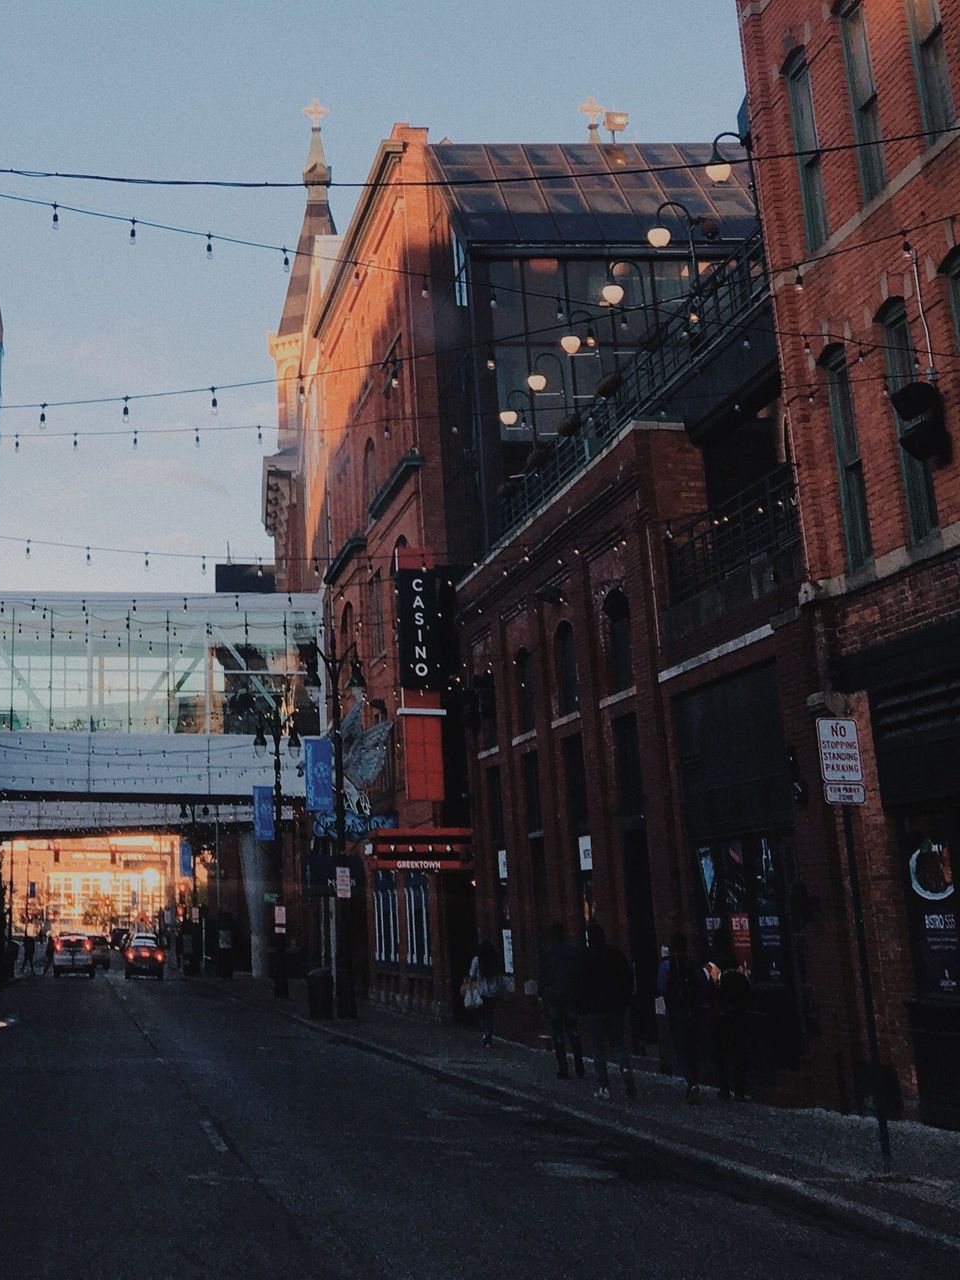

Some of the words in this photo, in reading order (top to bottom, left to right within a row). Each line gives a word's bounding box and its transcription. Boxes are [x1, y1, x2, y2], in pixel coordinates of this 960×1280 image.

[411, 578, 428, 677] CASINO
[830, 725, 847, 737] NO
[822, 740, 858, 750] STOPPING
[823, 752, 859, 762] STANDING
[825, 763, 860, 773] PARKING
[396, 860, 441, 869] GREEKTOWN
